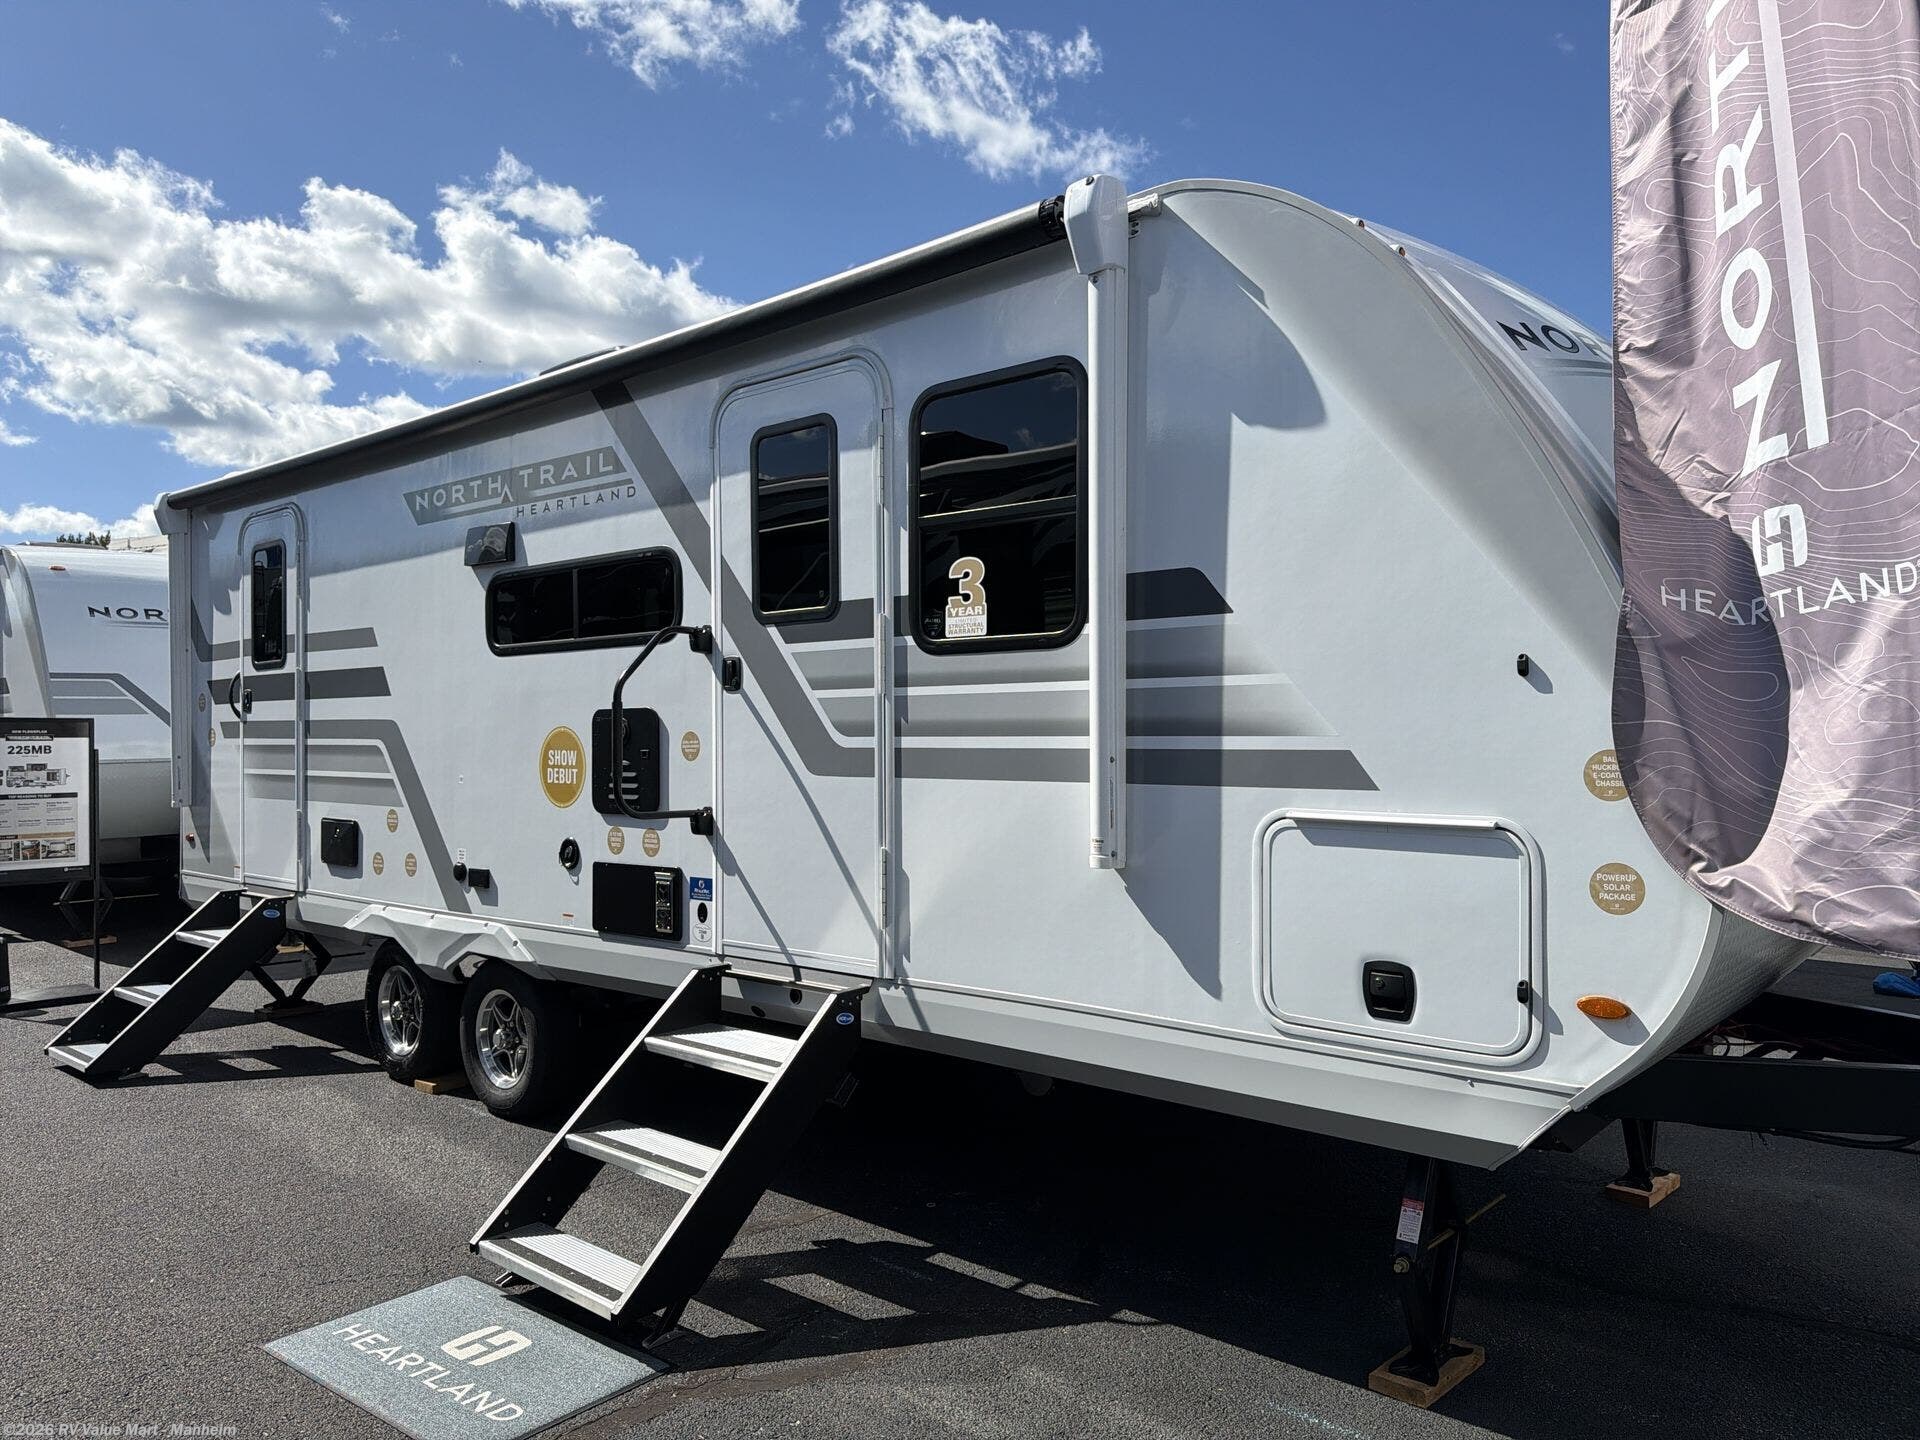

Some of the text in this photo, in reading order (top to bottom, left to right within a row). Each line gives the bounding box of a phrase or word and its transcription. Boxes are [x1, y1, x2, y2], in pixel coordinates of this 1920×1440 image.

[415, 452, 614, 511] NORTH TRAIL
[516, 485, 636, 518] HEARTLAND
[948, 556, 986, 608] 3
[1660, 561, 1918, 626] HEARTLAND
[950, 605, 983, 617] YEAR
[7, 745, 53, 755] 225MB
[548, 749, 578, 766] SHOW
[547, 767, 579, 785] DEBUT
[1596, 873, 1637, 882] POWERUP
[1603, 883, 1631, 892] SOLAR
[1599, 892, 1637, 901] PACKAGE
[332, 1322, 524, 1422] HEARTLAND
